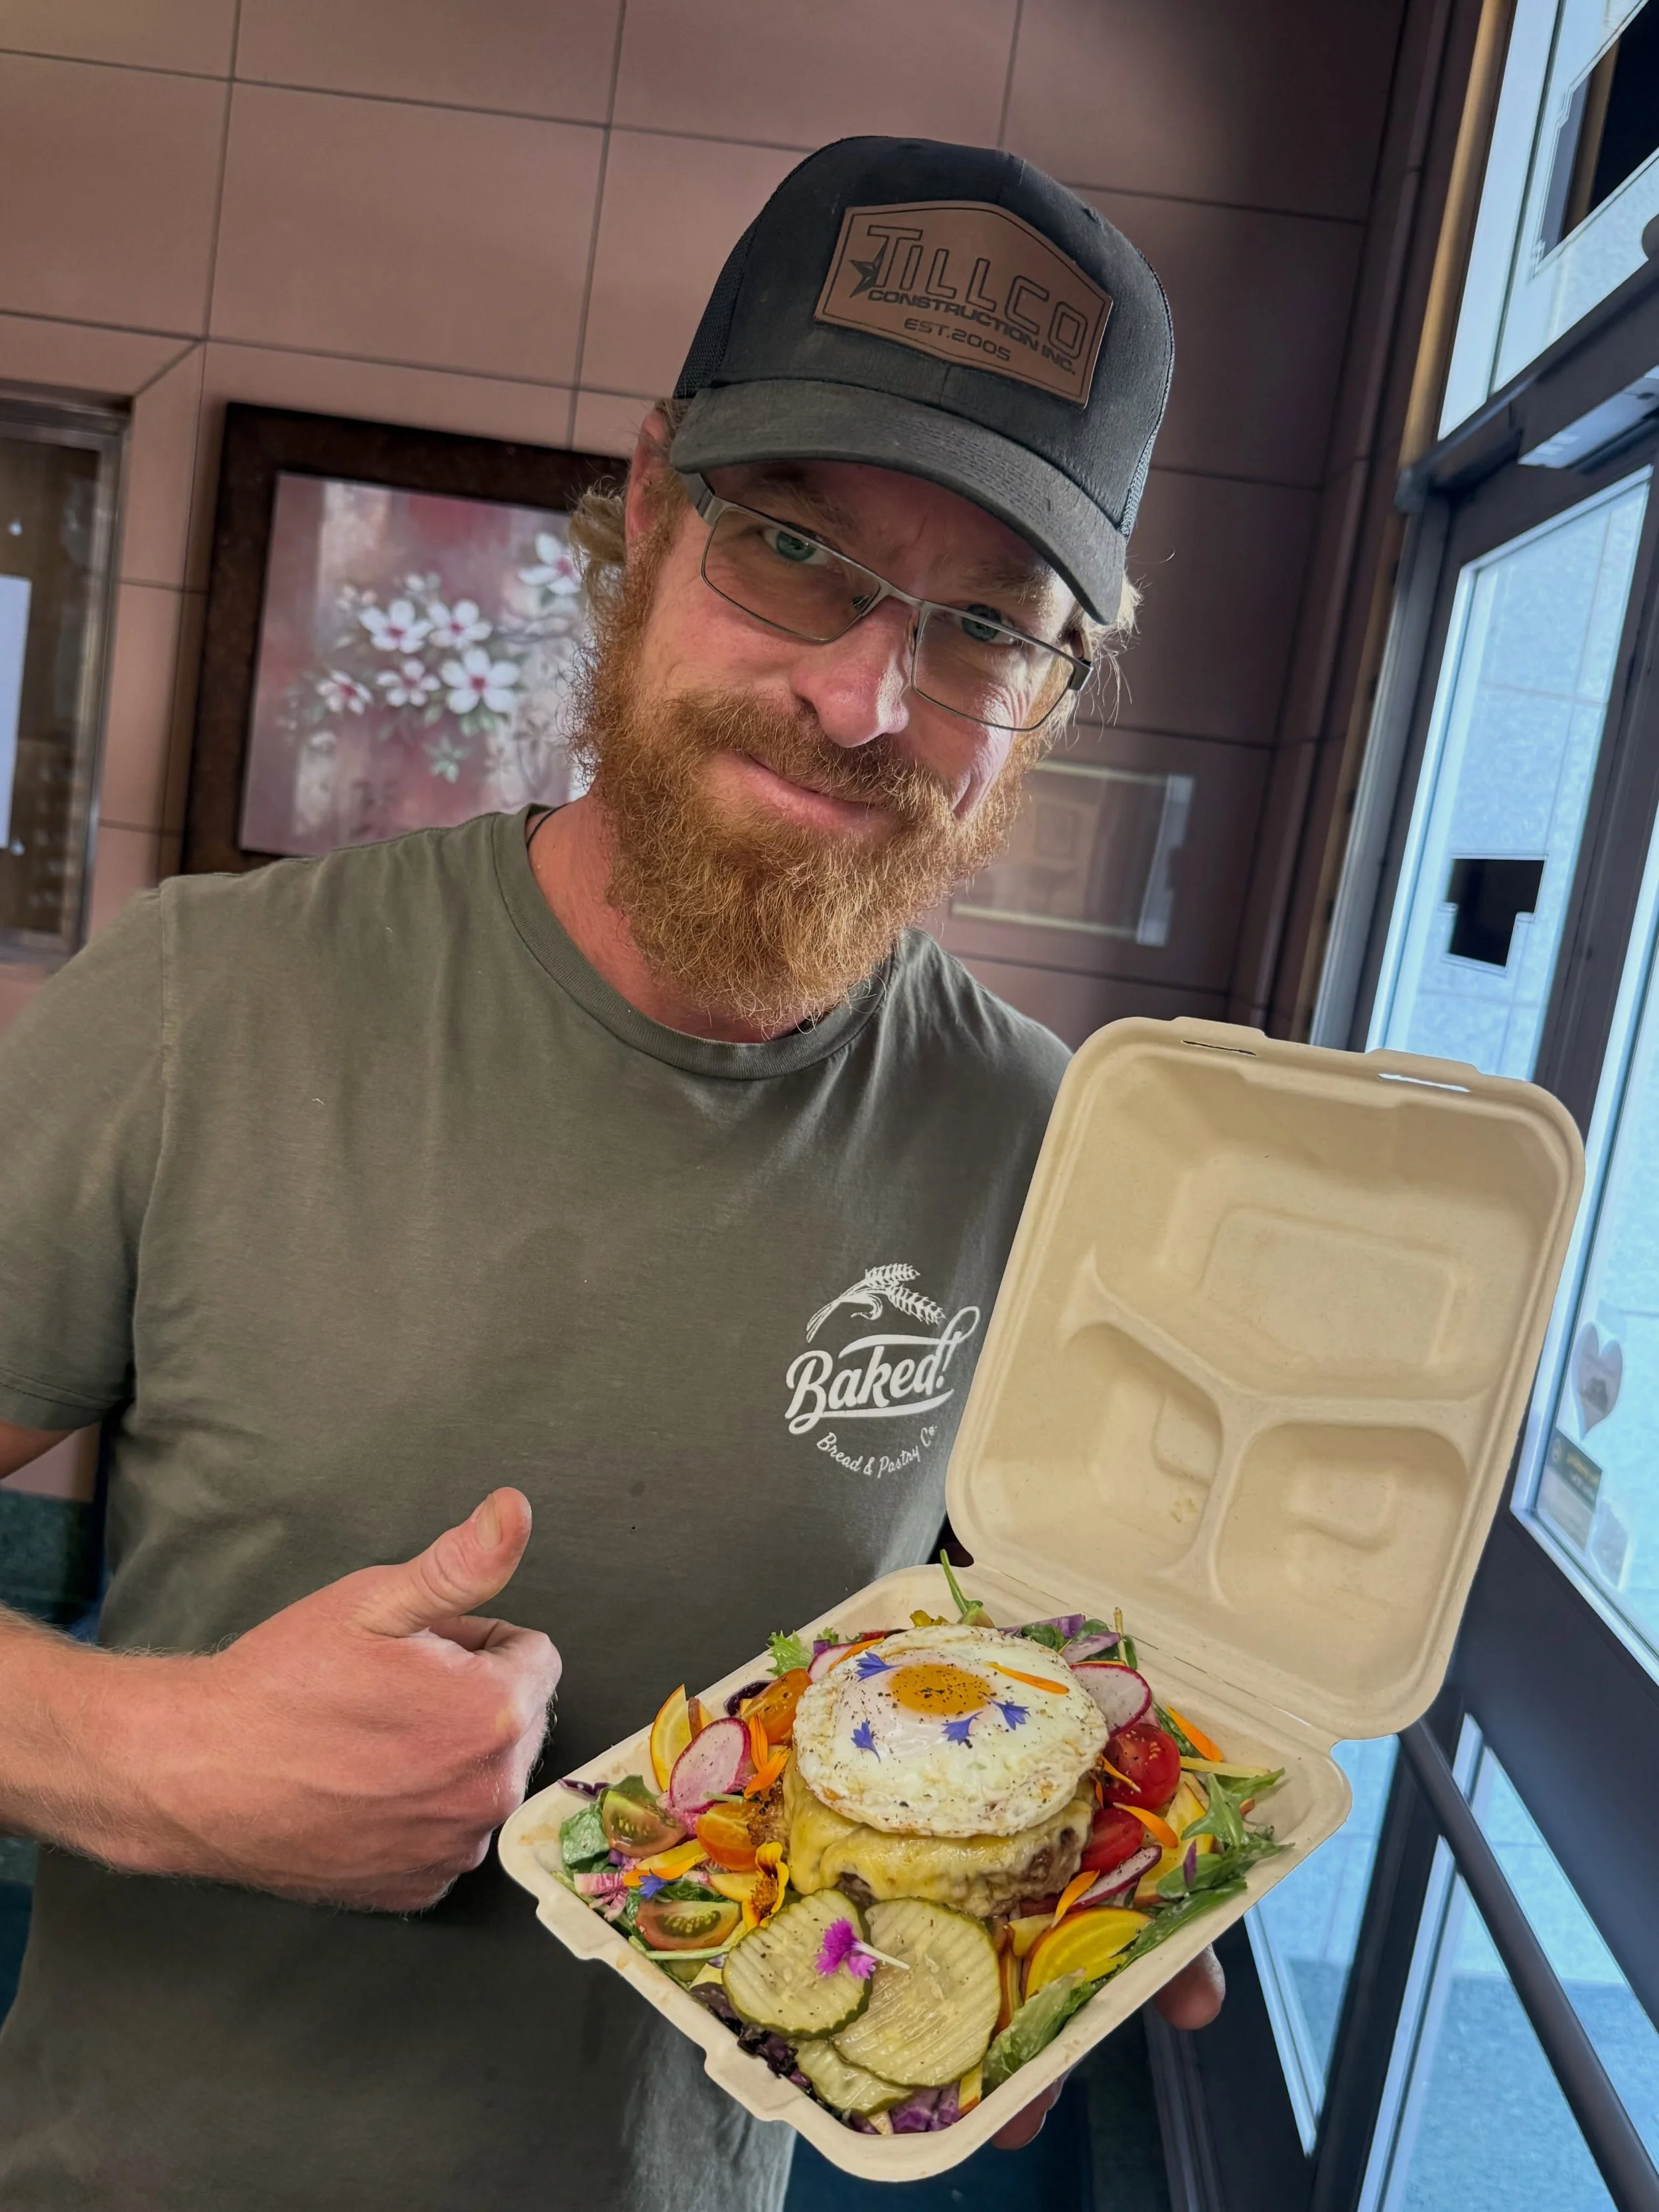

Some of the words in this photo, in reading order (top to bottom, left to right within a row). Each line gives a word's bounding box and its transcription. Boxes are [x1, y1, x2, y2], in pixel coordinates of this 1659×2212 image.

[867, 225, 1088, 359] TILLCO
[868, 289, 1039, 352] CONSTRUCTION
[1042, 344, 1076, 376] INC.
[784, 1306, 980, 1434] Baked!
[816, 1432, 862, 1473] Bread
[863, 1456, 874, 1476] &
[877, 1445, 921, 1478] Pastry
